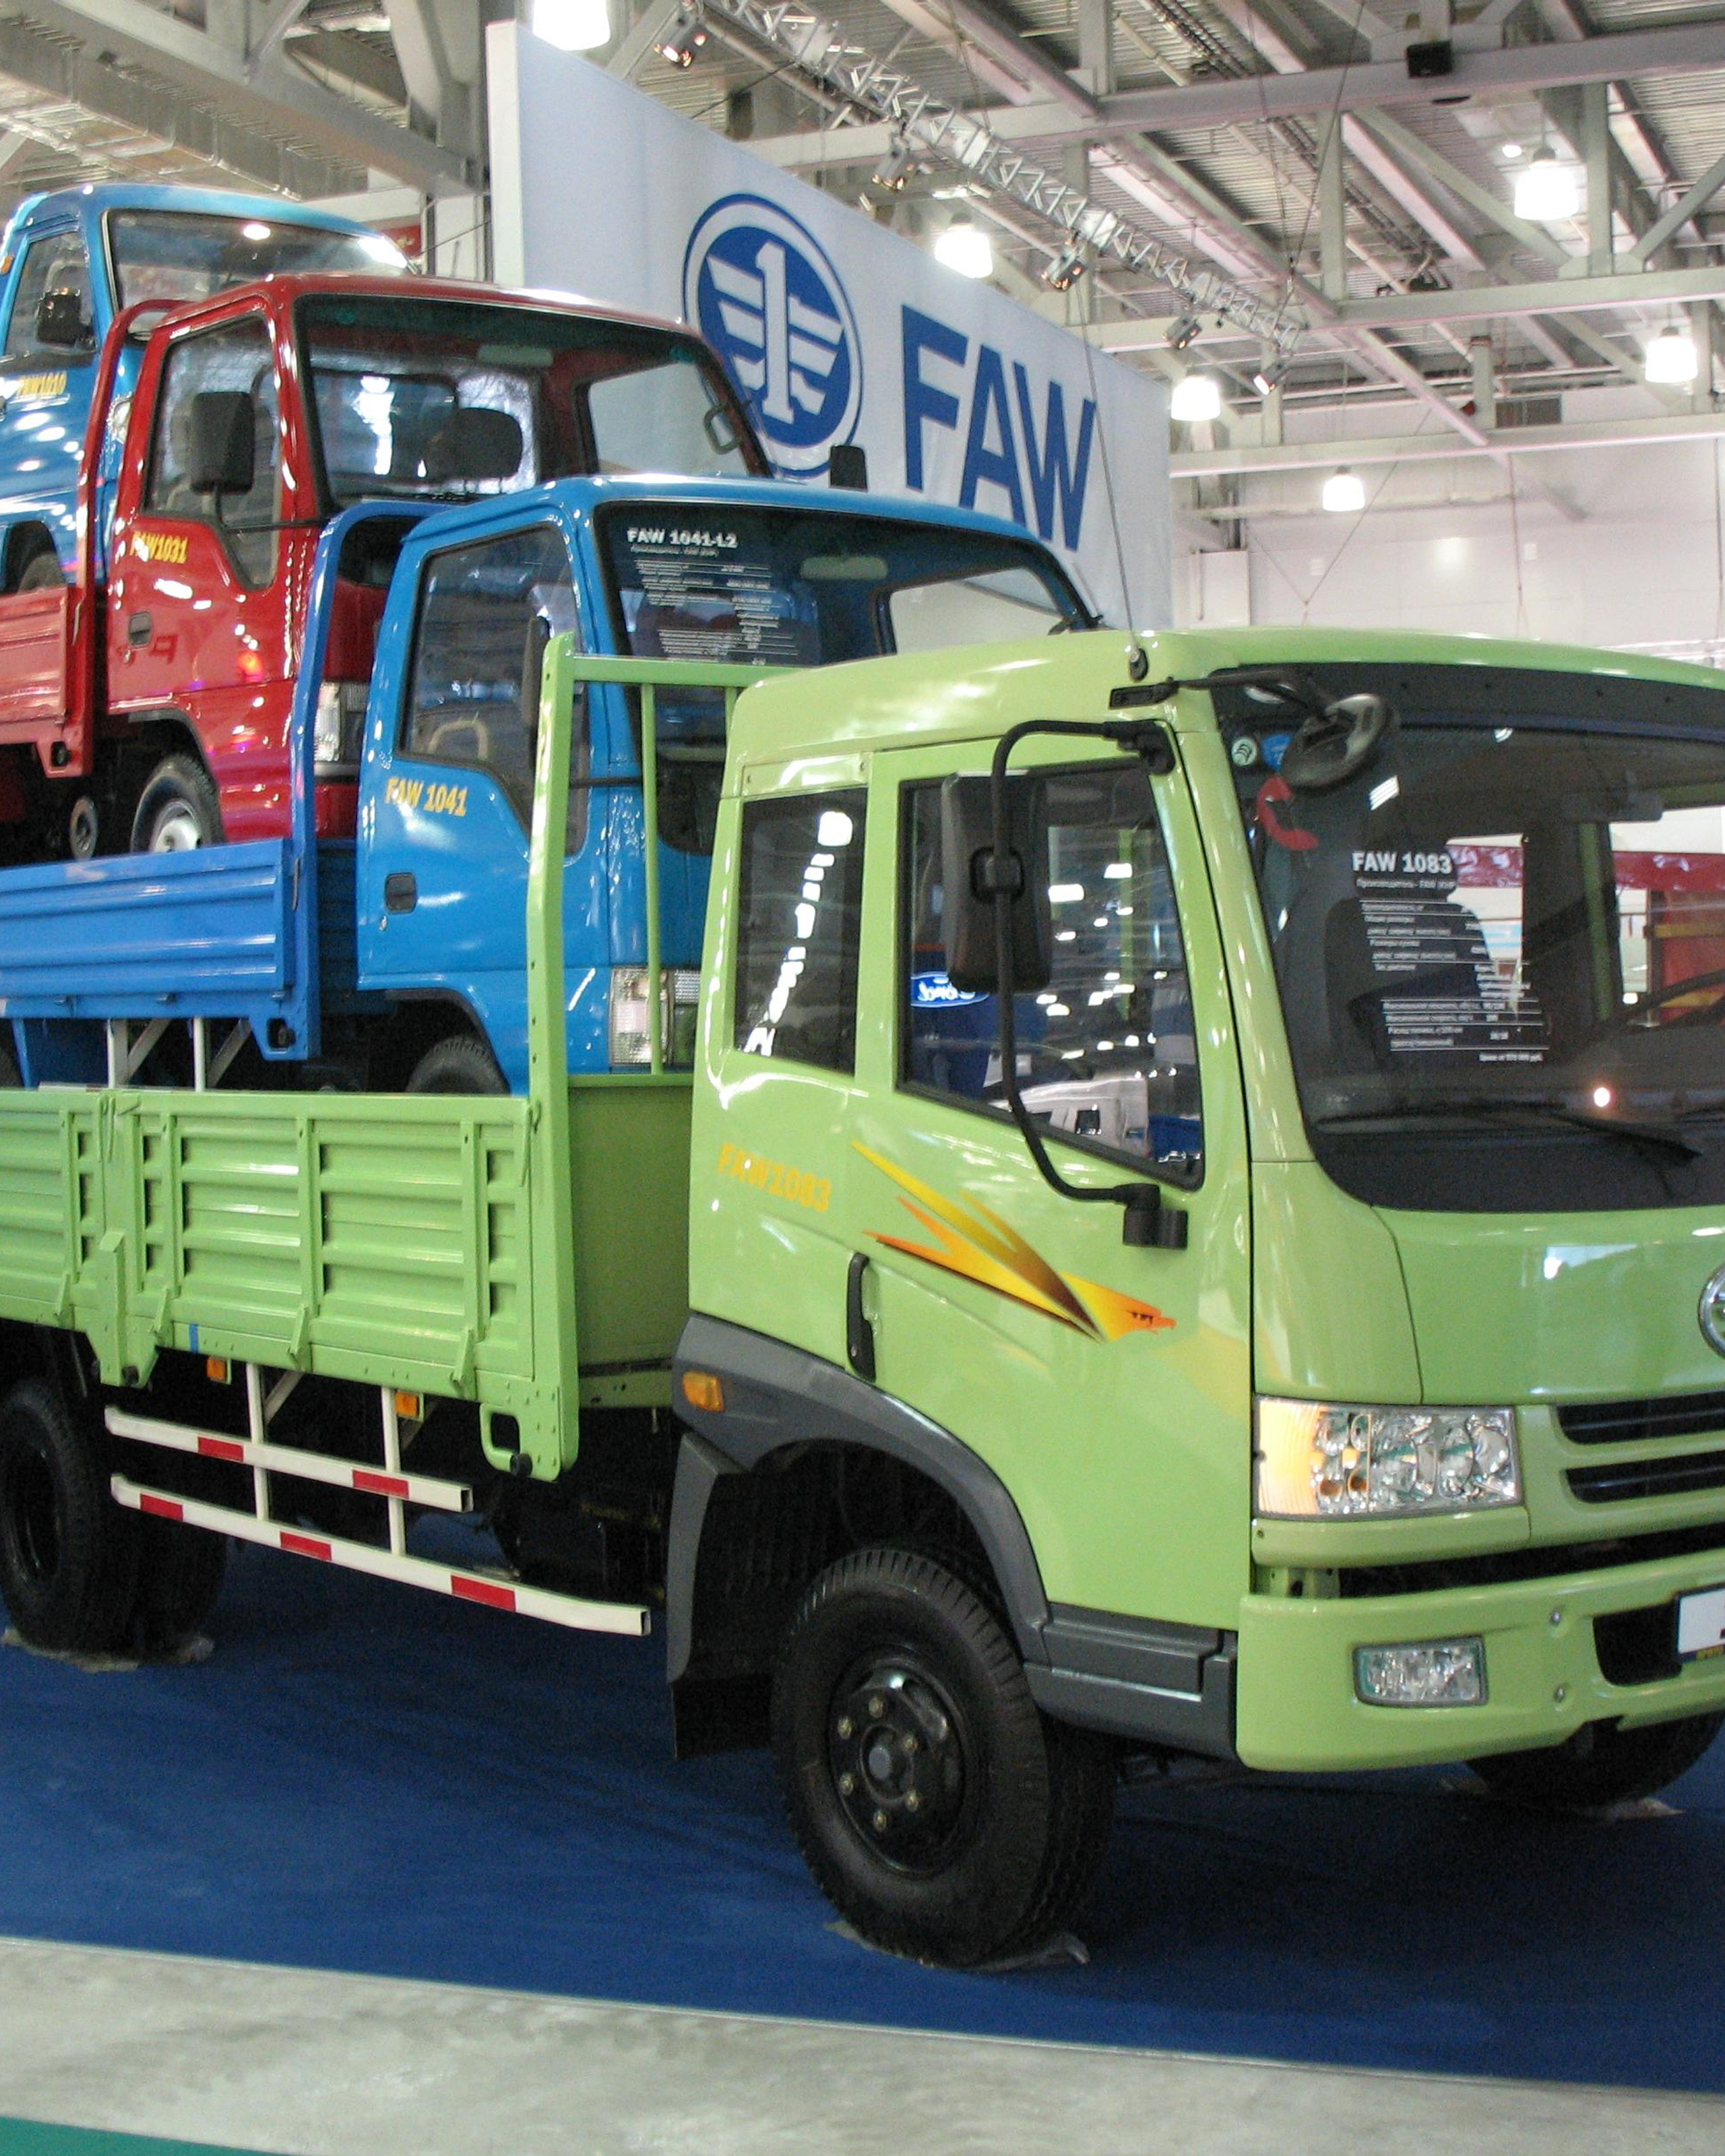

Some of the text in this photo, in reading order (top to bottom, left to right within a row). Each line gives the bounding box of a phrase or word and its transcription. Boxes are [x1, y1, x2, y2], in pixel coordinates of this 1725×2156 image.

[902, 305, 1097, 552] FAW
[627, 527, 738, 549] FAW 1041-L2
[384, 776, 468, 817] FAW 1041
[1352, 850, 1453, 874] FAW 1083
